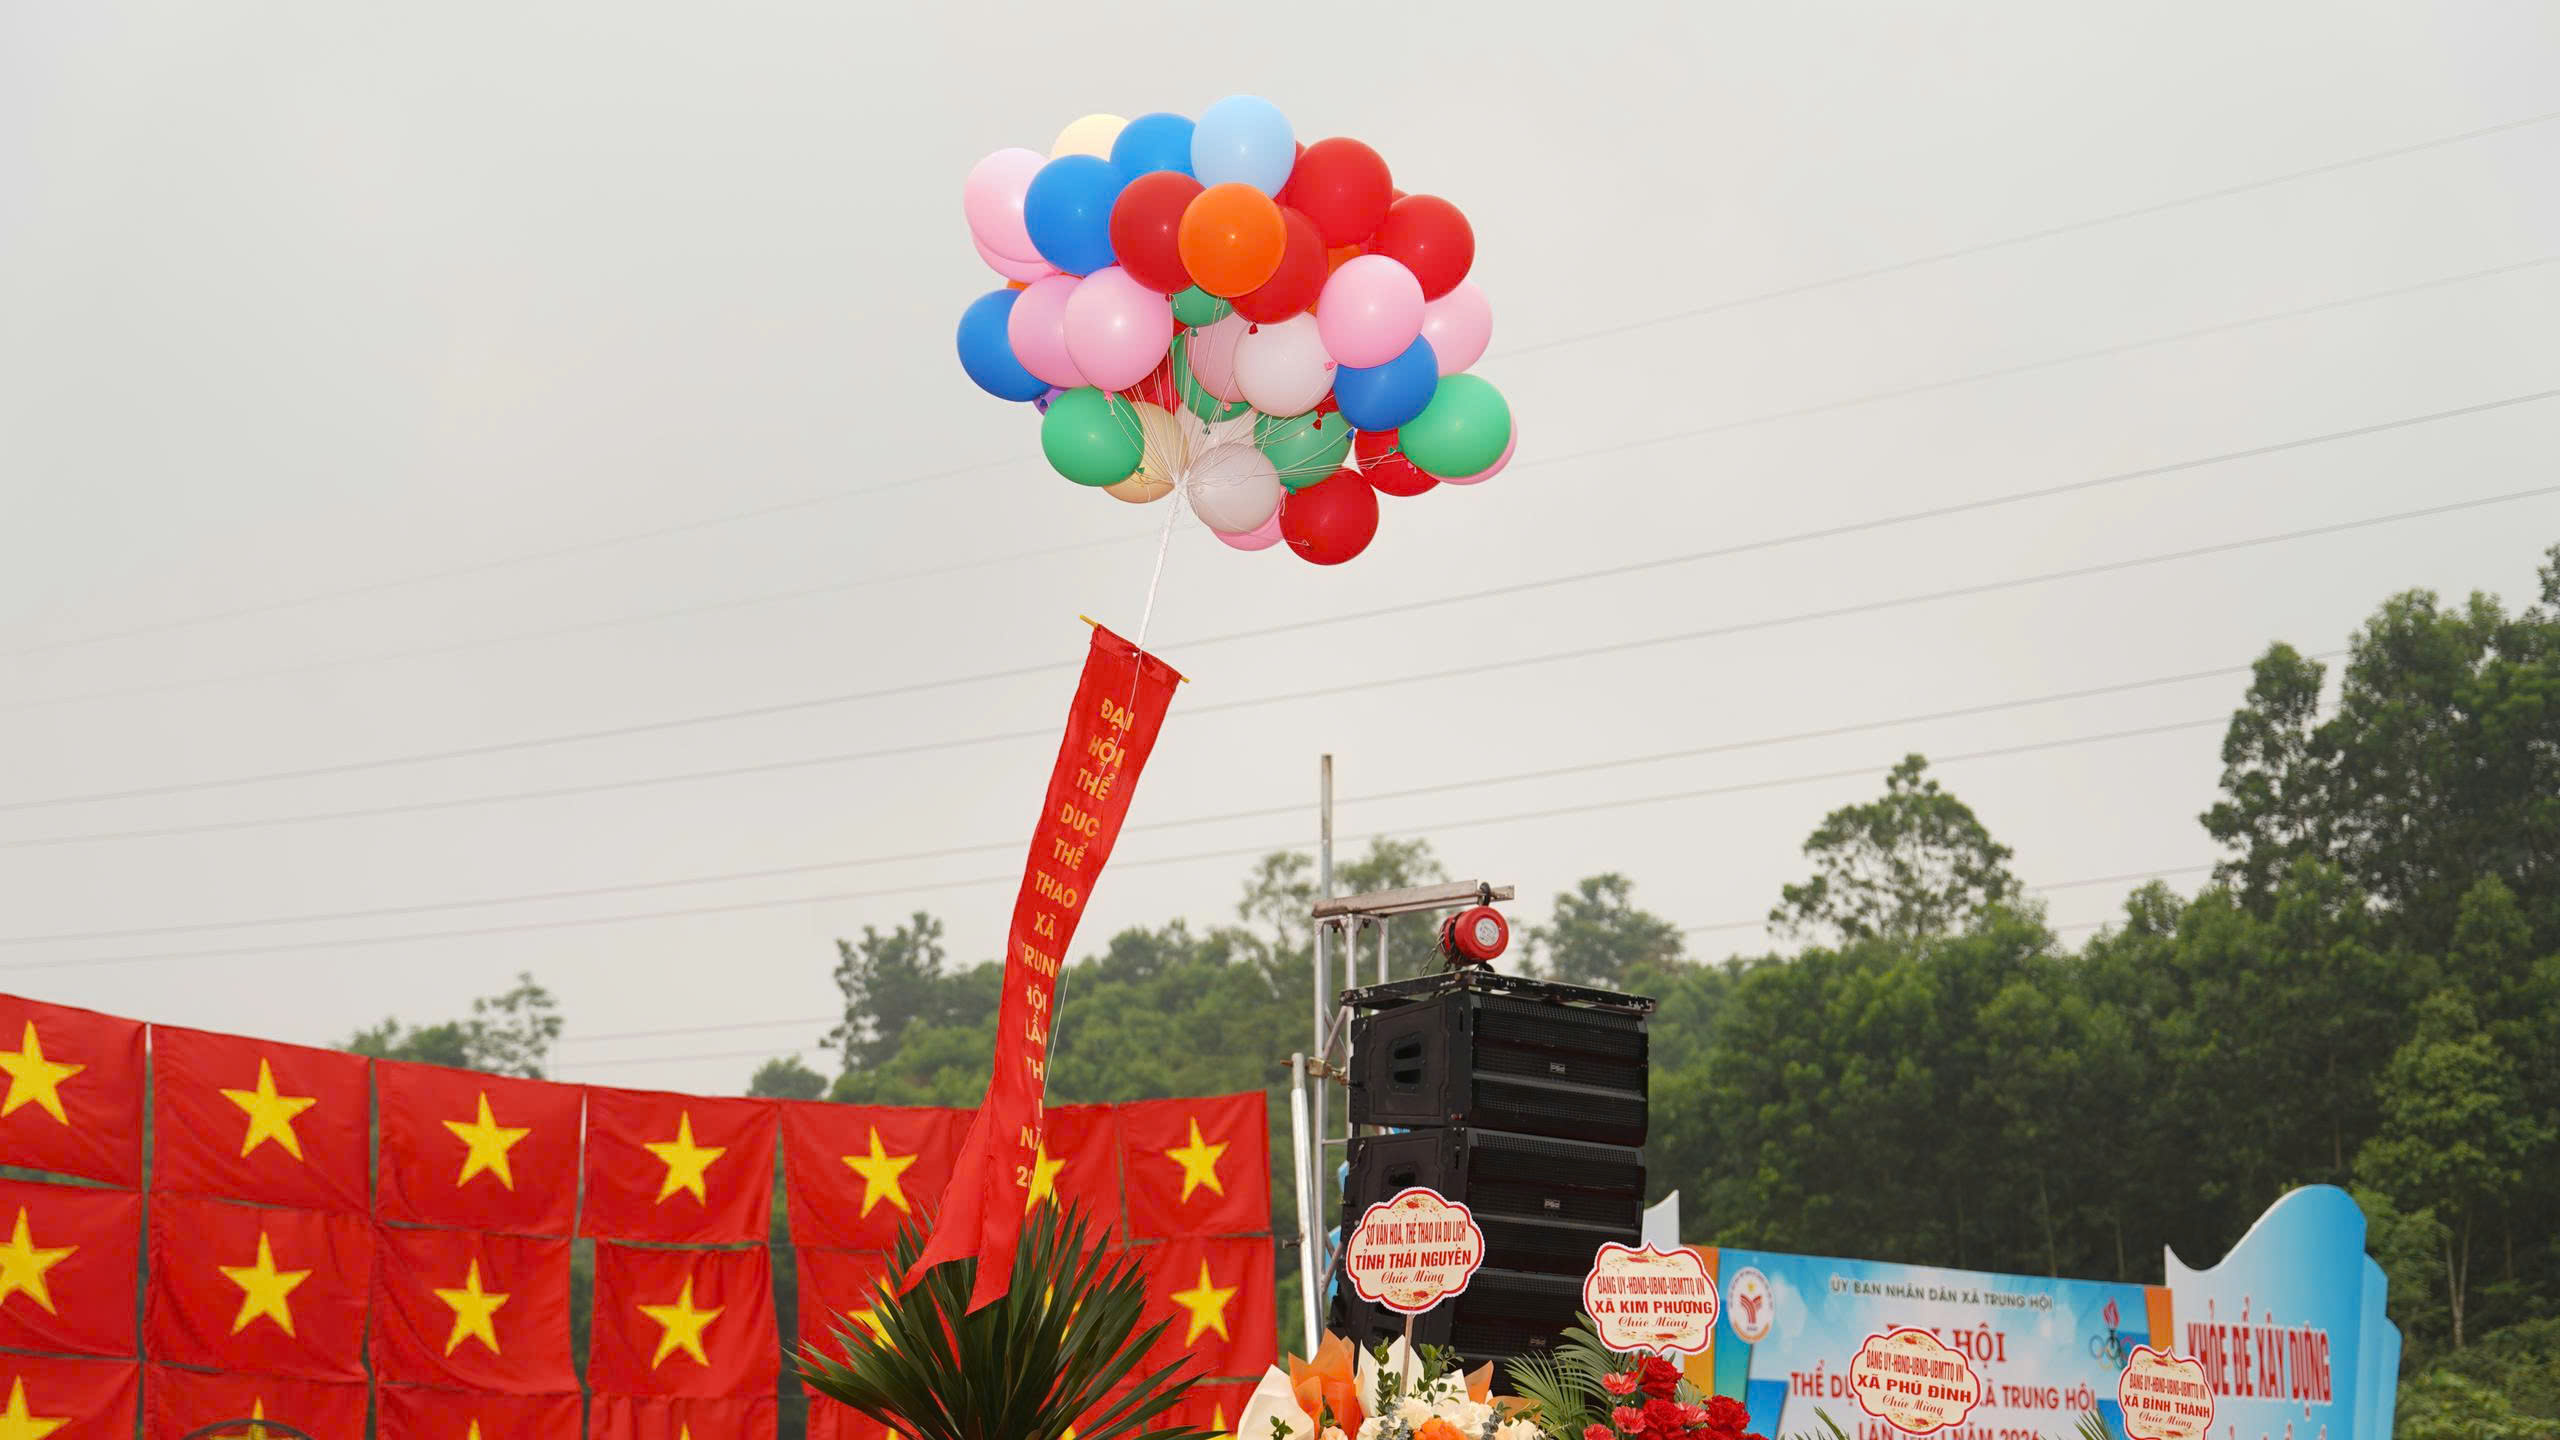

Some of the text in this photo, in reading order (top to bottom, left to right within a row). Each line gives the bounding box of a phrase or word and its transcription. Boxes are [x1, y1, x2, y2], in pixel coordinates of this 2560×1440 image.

[1100, 697, 1135, 732] ĐẠI
[1087, 734, 1126, 769] HỘI
[1075, 767, 1116, 801] THỂ
[1053, 837, 1089, 871] THỂ
[1034, 870, 1078, 909] THAO
[1417, 1221, 1434, 1244] THAO
[1443, 1221, 1452, 1242] DU
[1355, 1247, 1471, 1271] TỈNH THÁI NGUYÊN
[1381, 1270, 1445, 1284] Chúc Mừng
[1595, 1298, 1713, 1317] XÃ KIM PHƯỢNG
[1853, 1281, 1880, 1295] BAN
[1886, 1283, 1924, 1300] NHÂN
[1929, 1286, 1957, 1302] DÂN
[1984, 1292, 2025, 1308] TRUNG
[2030, 1295, 2053, 1312] HỘI
[1619, 1316, 1688, 1328] Chúc Mừng
[1953, 1322, 2006, 1368] HỘI
[2232, 1297, 2253, 1396] ĐỂ
[2256, 1312, 2285, 1399] XÂY
[1791, 1359, 1824, 1397] THỂ
[2002, 1385, 2059, 1410] TRUNG
[1857, 1373, 1881, 1389] XÃ
[1928, 1384, 1972, 1403] ĐÌNH
[1882, 1394, 1944, 1416] Chúc Mừng
[2124, 1393, 2138, 1408] XÃ
[2143, 1396, 2170, 1412] BÌNH
[2139, 1411, 2192, 1429] Chúc Mừng
